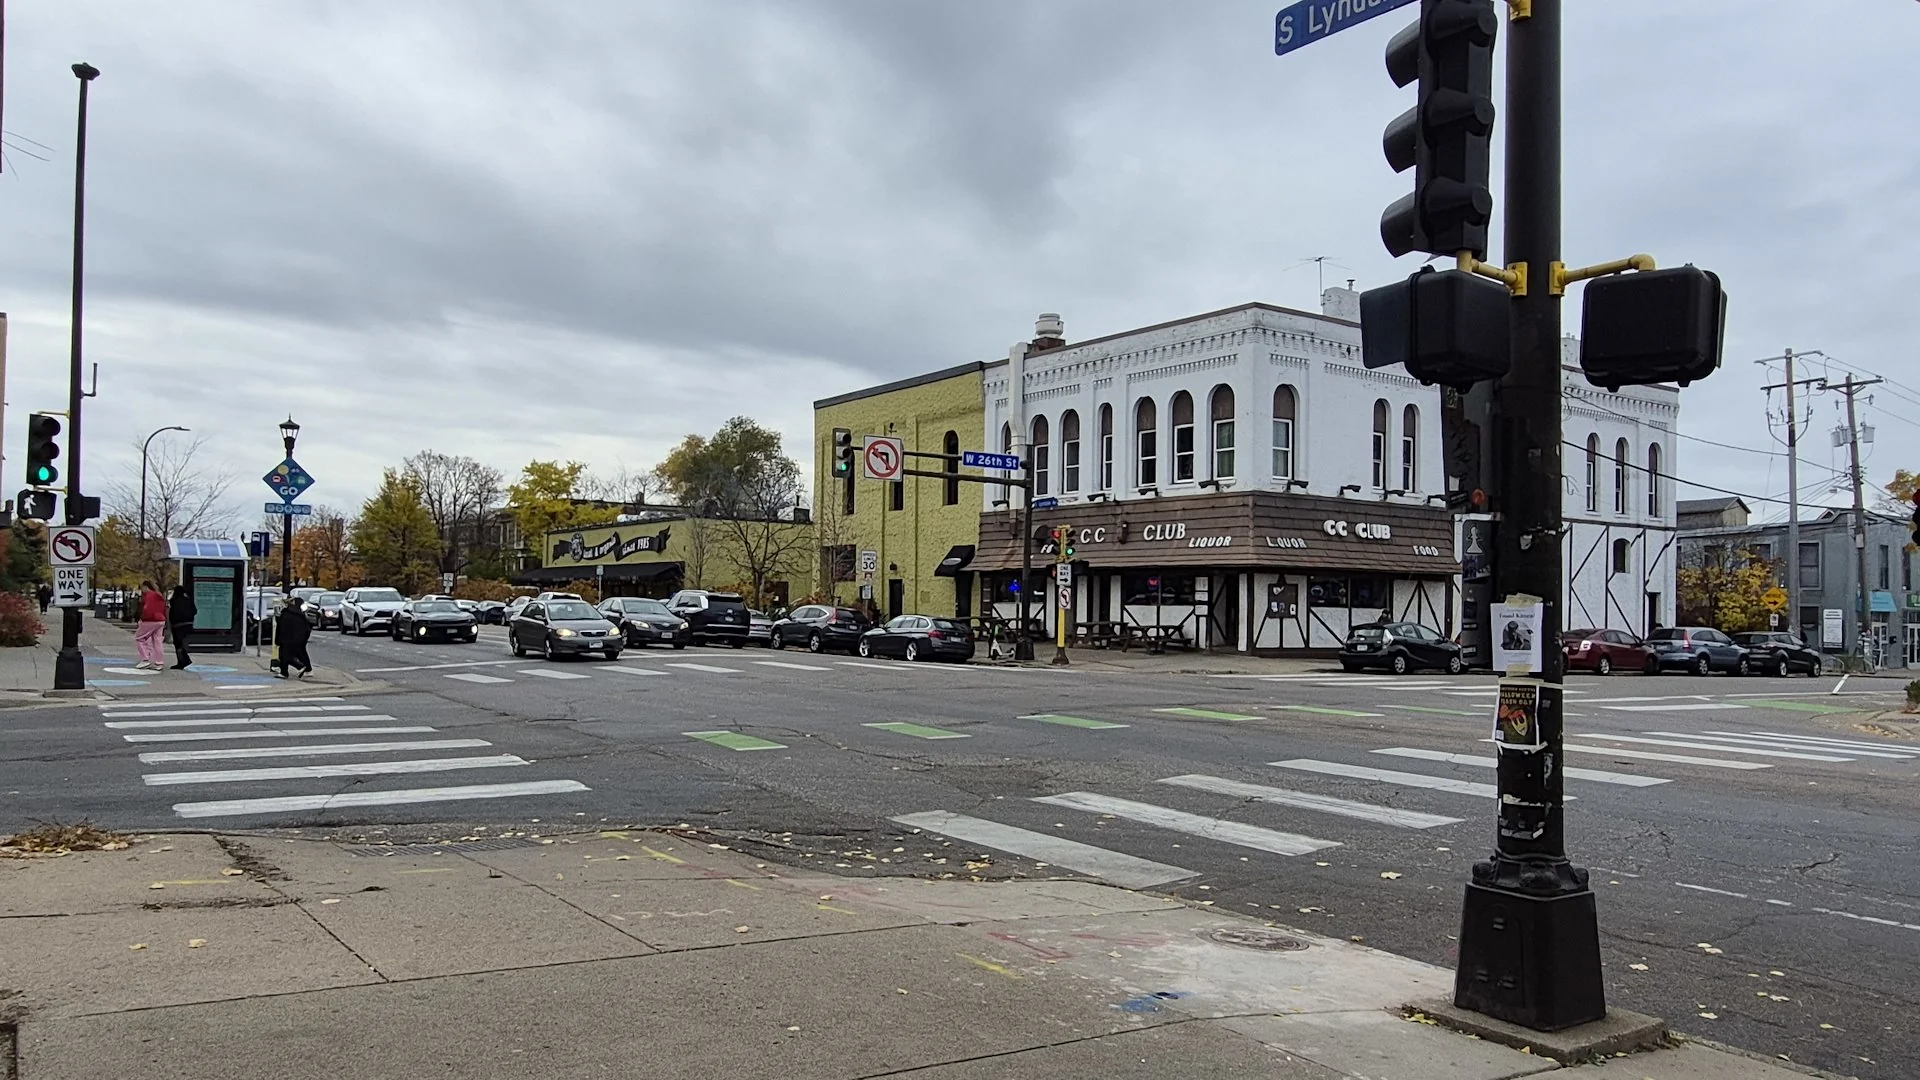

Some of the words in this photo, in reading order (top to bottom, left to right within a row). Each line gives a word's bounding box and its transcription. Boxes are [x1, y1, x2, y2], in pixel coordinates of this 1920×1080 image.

[1279, 15, 1293, 44] S
[965, 454, 974, 464] W
[978, 455, 1003, 467] 26th
[1006, 457, 1018, 468] St
[280, 486, 298, 495] GO
[1143, 523, 1186, 541] CLUB
[1324, 519, 1348, 537] CC
[1355, 522, 1392, 540] CLUB
[1188, 536, 1232, 548] LIQUOR
[1266, 536, 1307, 548] LQUOR
[1413, 545, 1439, 556] FOOD
[863, 561, 875, 570] 30
[58, 569, 84, 579] ONE
[58, 581, 84, 590] WAY
